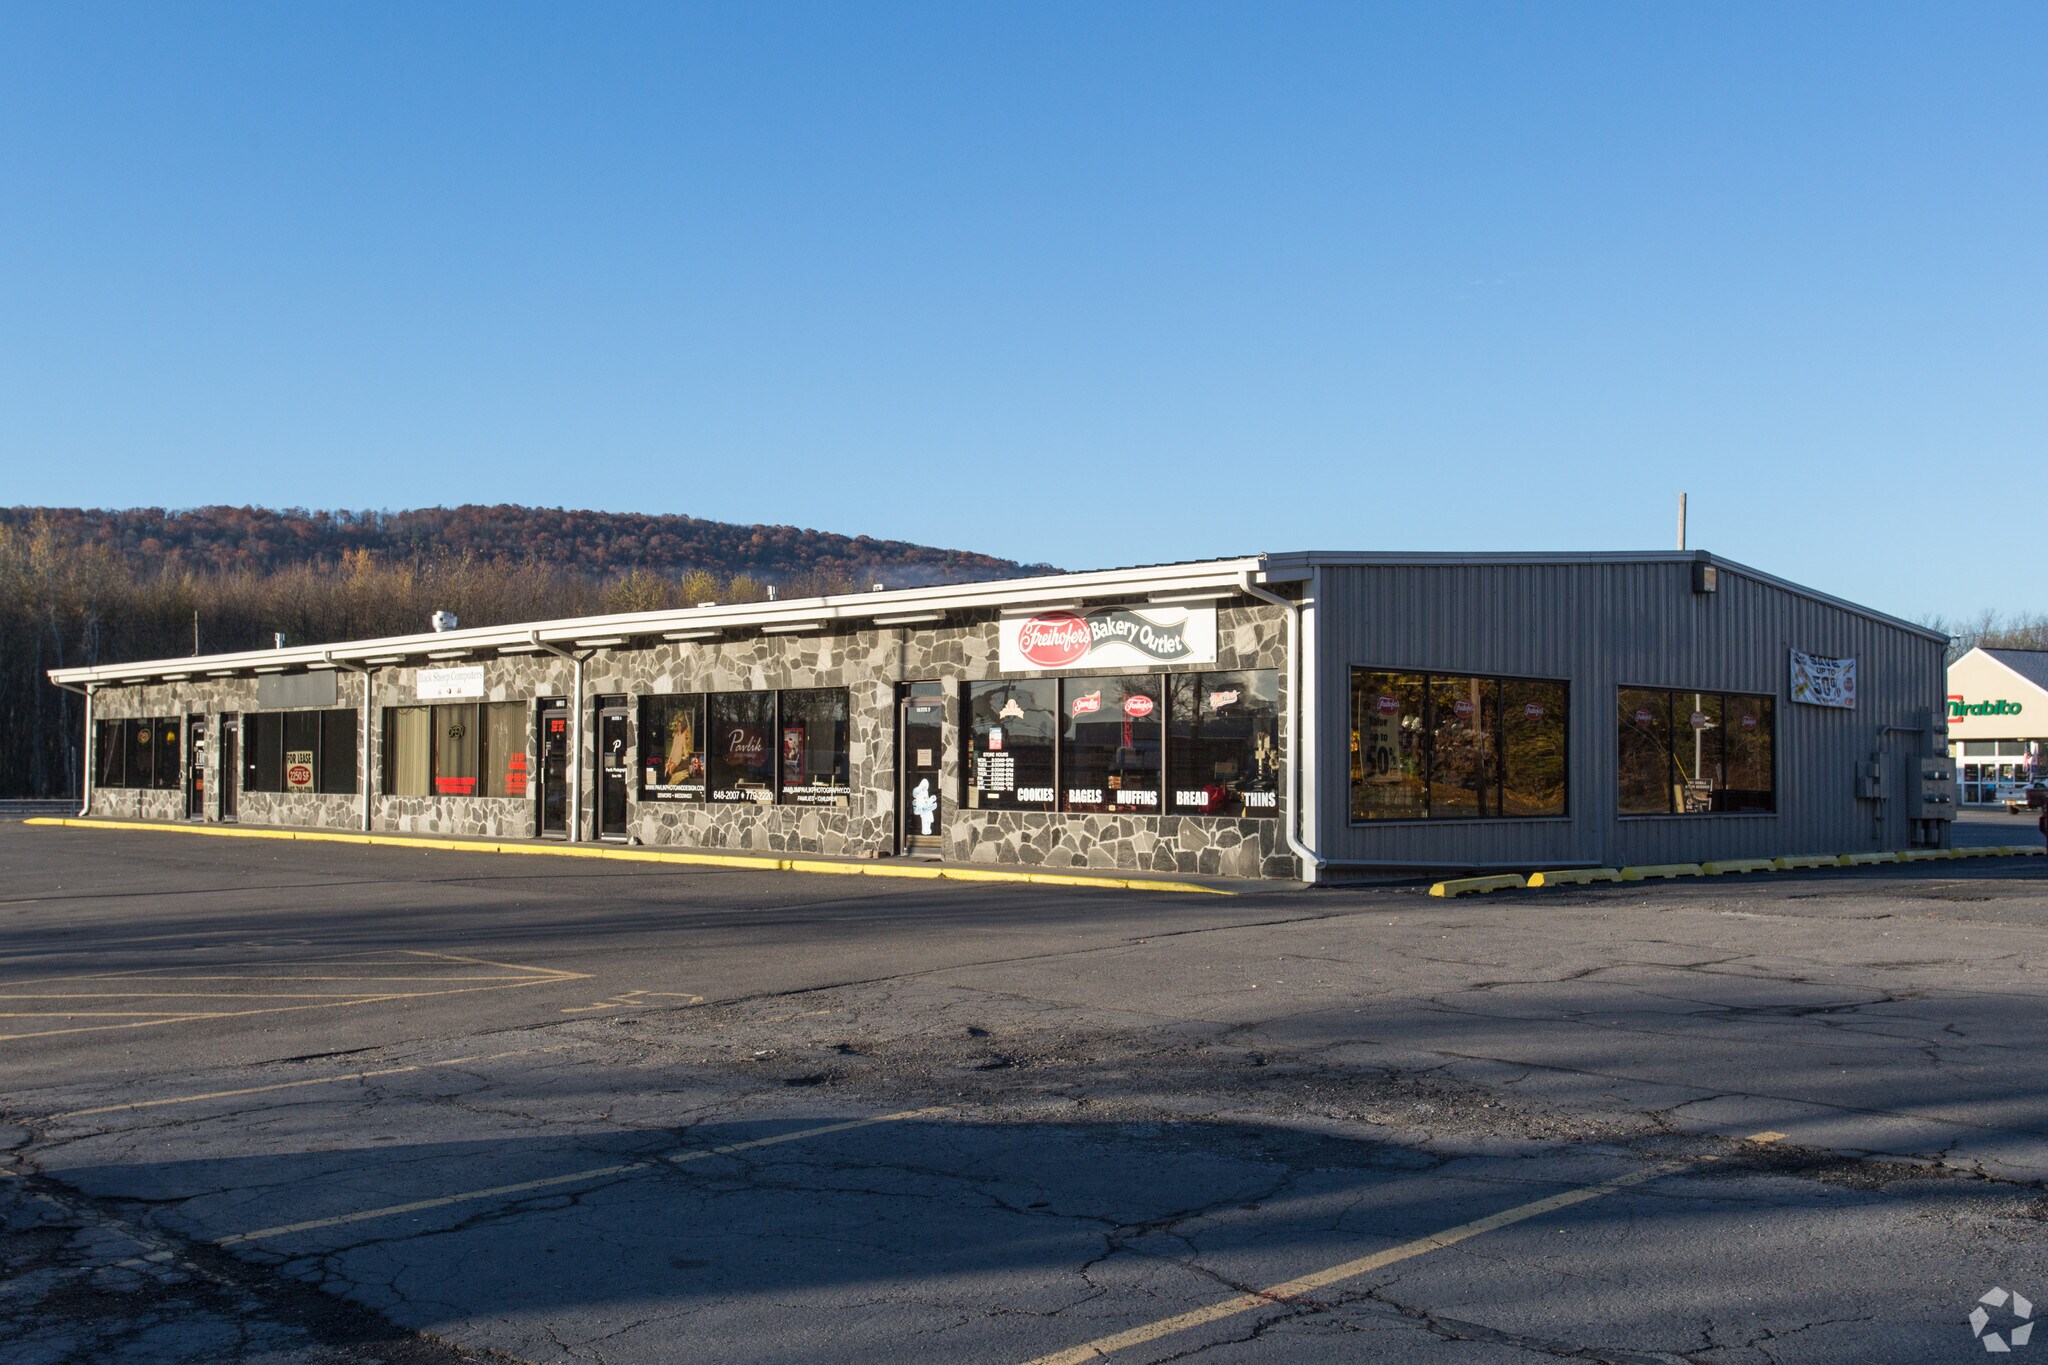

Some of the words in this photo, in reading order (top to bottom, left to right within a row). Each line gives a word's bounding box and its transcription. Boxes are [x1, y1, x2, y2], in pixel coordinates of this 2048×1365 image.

[1019, 619, 1091, 653] Freihofer's
[1090, 616, 1140, 642] Bakery
[1140, 625, 1183, 653] Outlet
[433, 671, 450, 683] Sheep
[450, 670, 483, 683] Computers
[728, 728, 762, 752] Pavlik
[1380, 732, 1388, 742] to
[287, 753, 296, 764] FOR
[297, 753, 311, 764] LEASE
[289, 771, 302, 781] 2250
[713, 790, 739, 800] 648-2007
[745, 791, 773, 801] 779-2220
[1017, 788, 1054, 802] COOKIES
[1069, 789, 1102, 804] BAGELS
[1116, 790, 1157, 805] MUFFINS
[1176, 791, 1209, 806] BREAD
[1244, 792, 1276, 807] THINS
